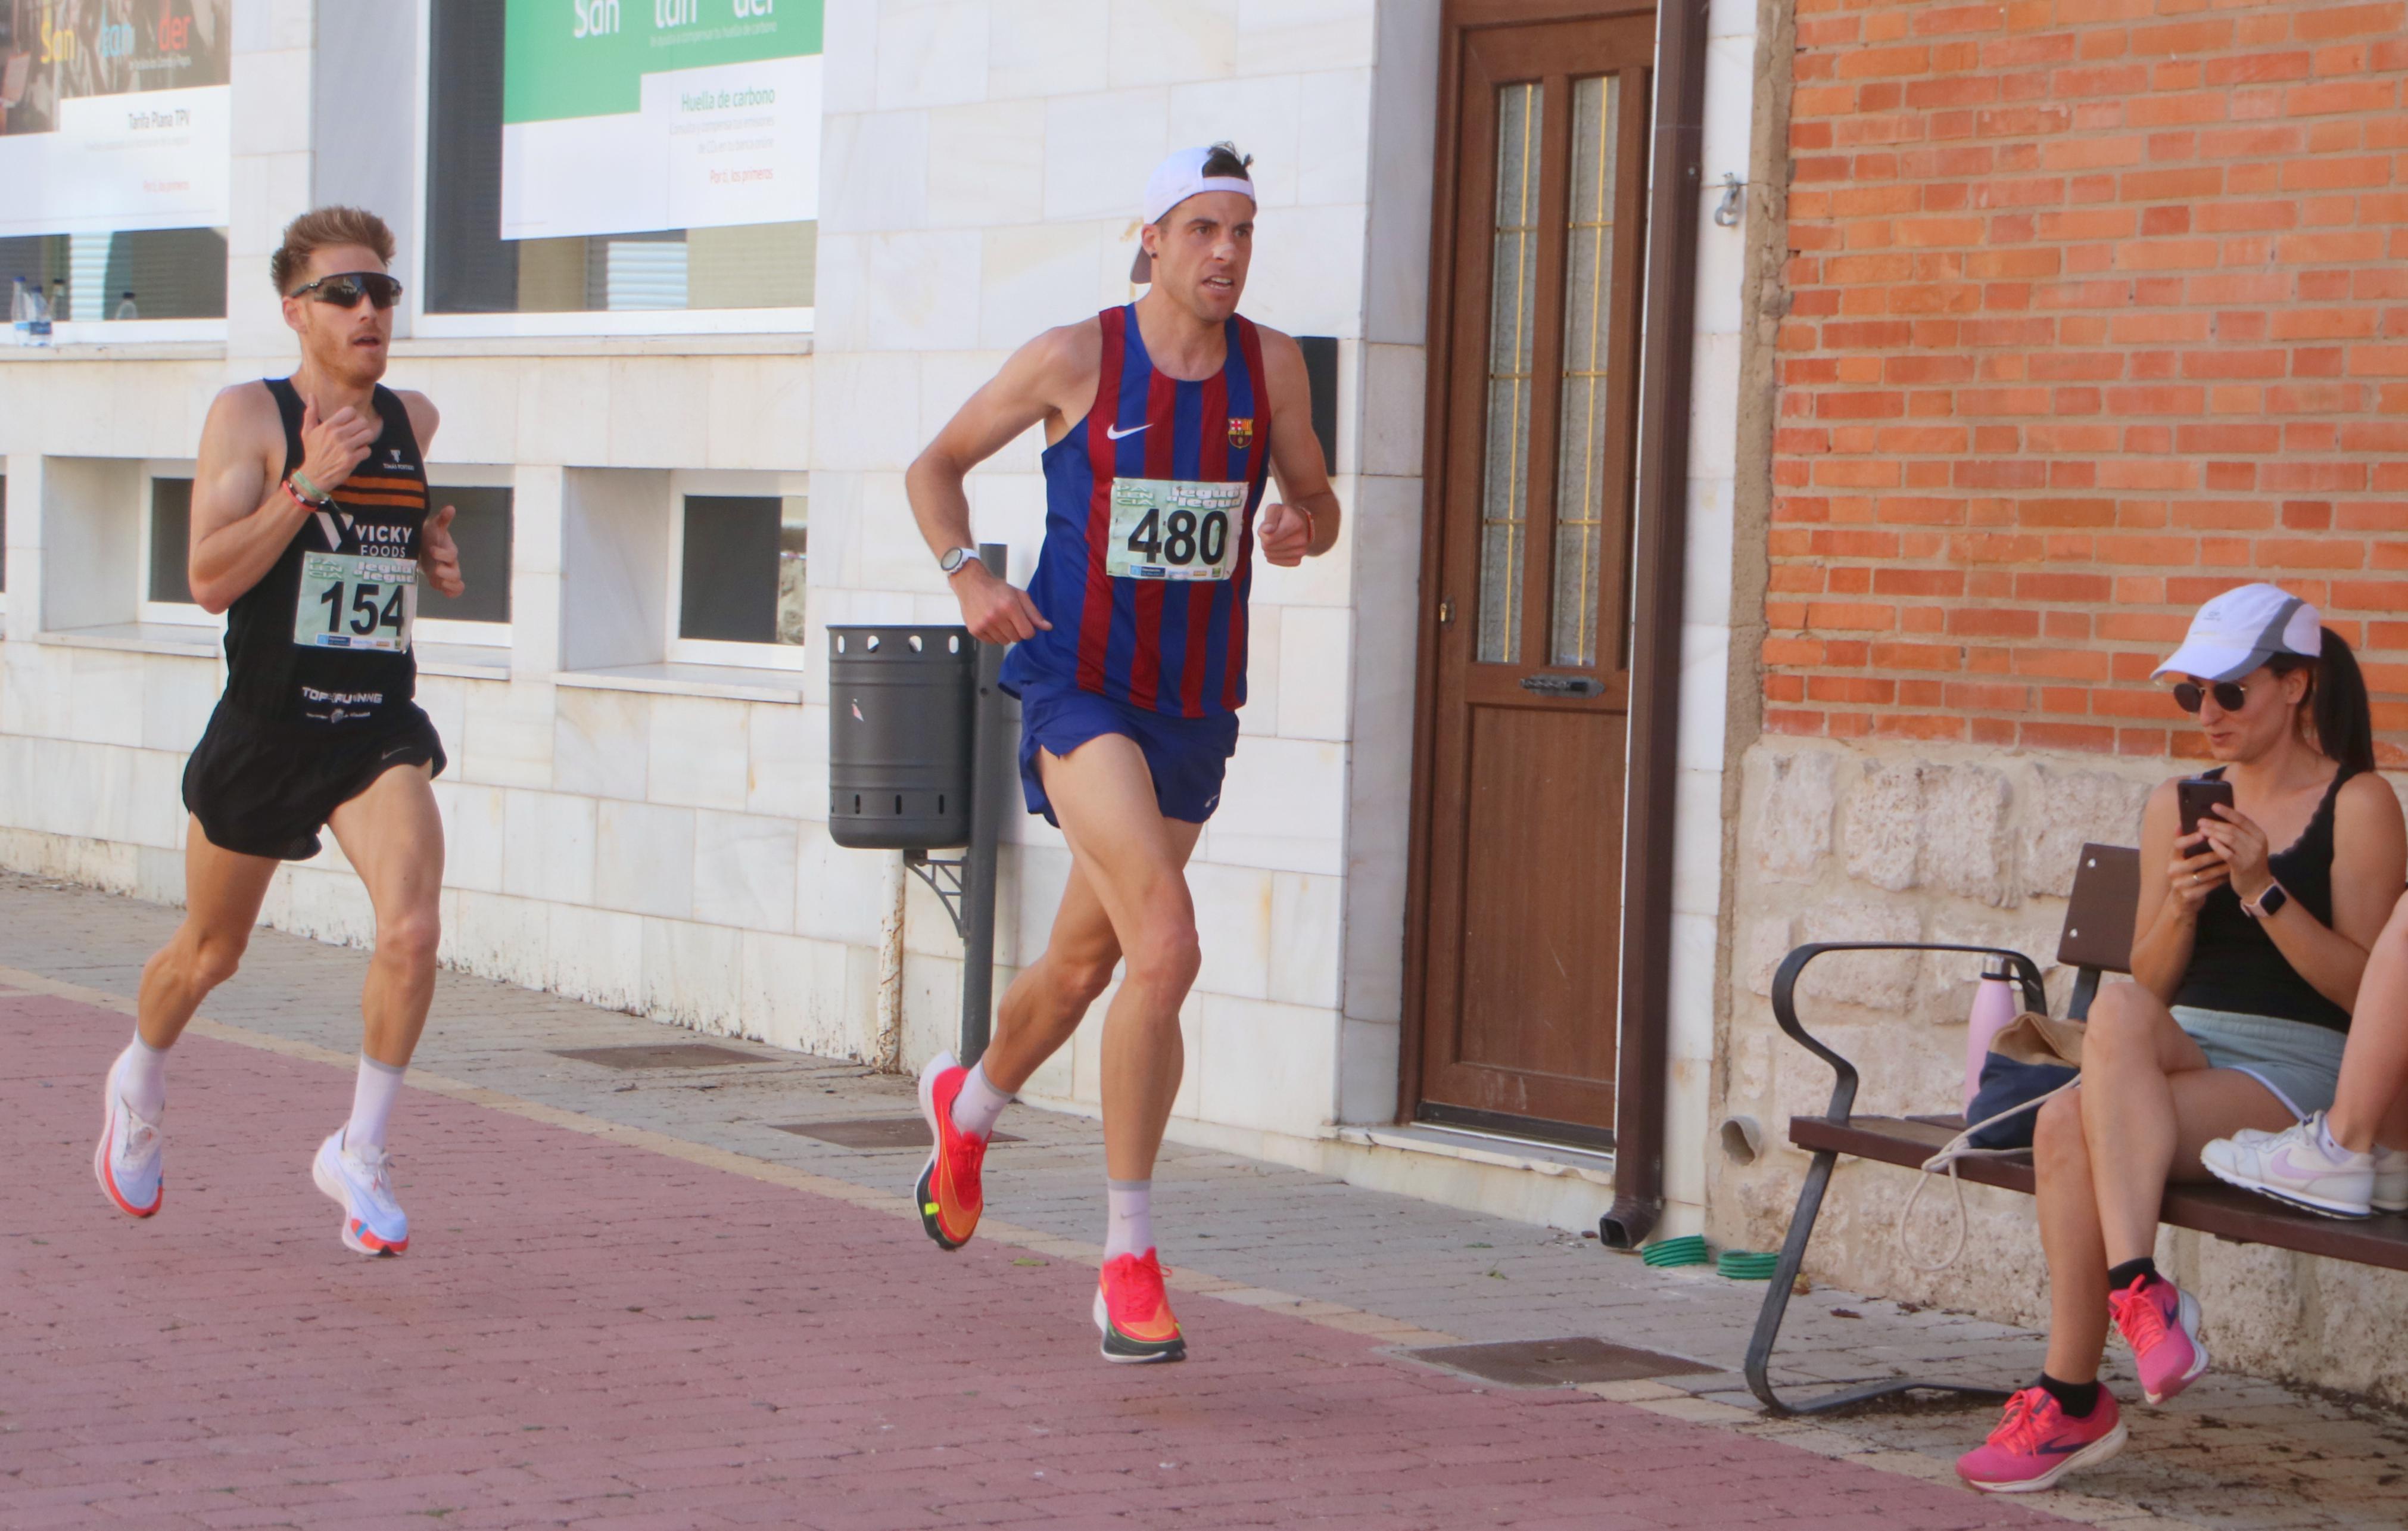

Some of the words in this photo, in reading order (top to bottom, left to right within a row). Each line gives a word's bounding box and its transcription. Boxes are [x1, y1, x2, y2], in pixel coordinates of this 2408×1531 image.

[157, 10, 191, 51] der
[681, 90, 715, 112] Huella
[718, 88, 730, 108] de
[733, 86, 775, 107] carbono
[356, 524, 413, 543] VICKY
[1127, 508, 1228, 565] 480
[361, 544, 406, 558] FOODS
[320, 581, 405, 637] 154
